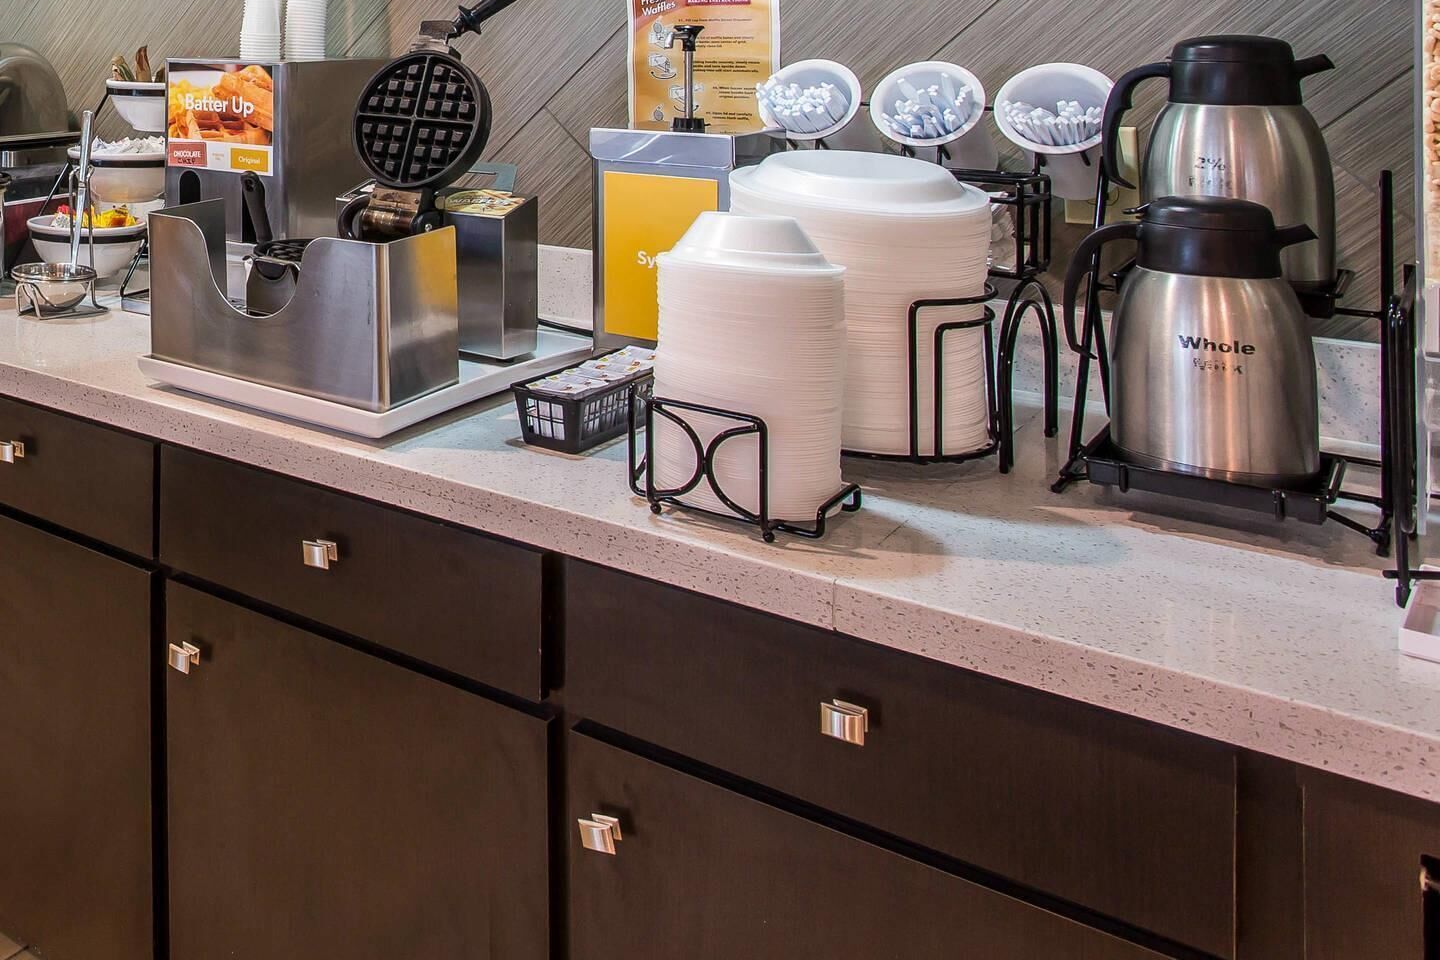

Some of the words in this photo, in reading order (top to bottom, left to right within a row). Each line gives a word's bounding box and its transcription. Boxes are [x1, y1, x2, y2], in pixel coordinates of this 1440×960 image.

[641, 0, 676, 17] Waffles
[185, 93, 228, 113] Batter
[231, 95, 255, 117] Up
[173, 150, 201, 158] CHOCOLATE
[238, 155, 261, 166] Original
[1195, 156, 1227, 171] 2%
[1177, 334, 1256, 355] Whole
